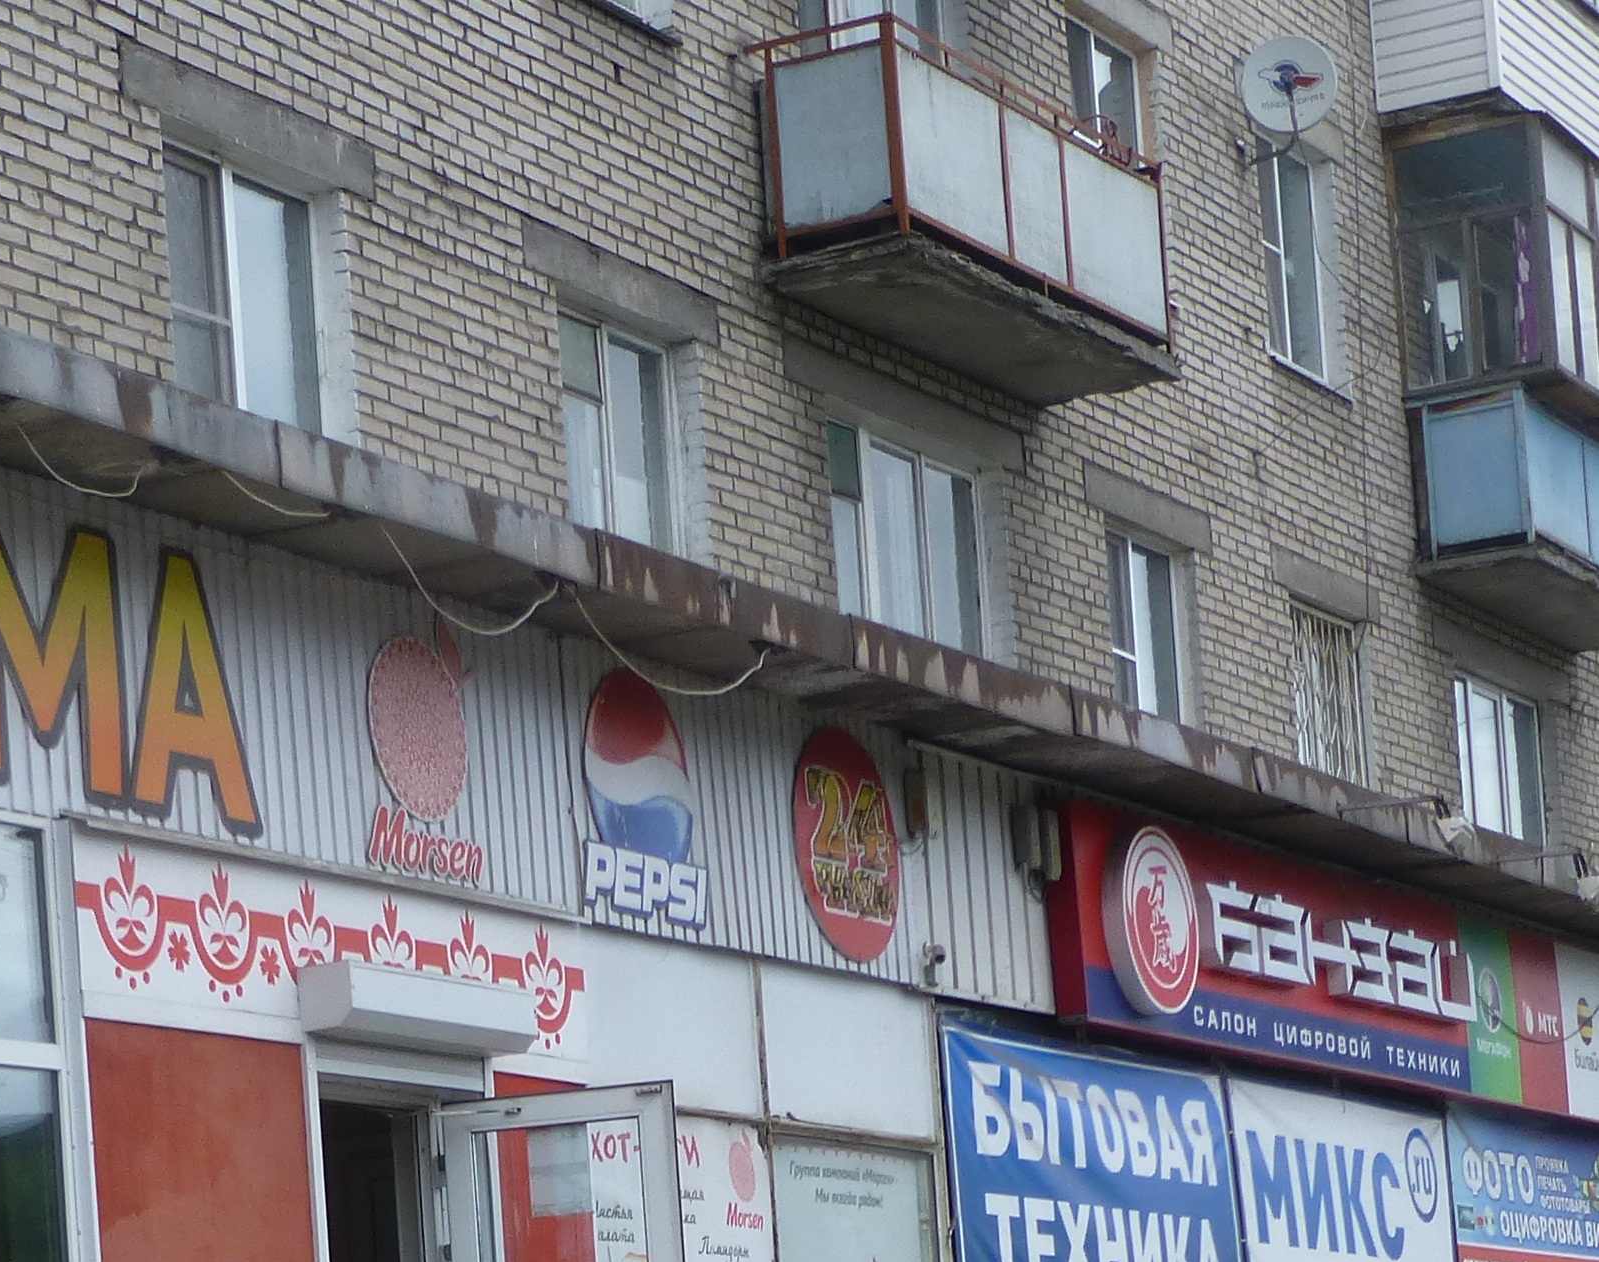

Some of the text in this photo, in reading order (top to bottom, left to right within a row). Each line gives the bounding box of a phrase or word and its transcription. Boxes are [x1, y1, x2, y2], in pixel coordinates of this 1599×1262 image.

[368, 804, 484, 885] Morsen
[583, 841, 708, 931] PEPSI
[1192, 1005, 1461, 1078] САЛОН ЦИФРОВОЙ ТЕХНИКИ
[1537, 1010, 1560, 1038] МТС
[968, 1061, 1219, 1187] БЫТОВАЯ
[815, 1187, 830, 1202] Мы
[1245, 1129, 1405, 1261] МИКС
[1412, 1155, 1433, 1196] .ru
[1462, 1147, 1534, 1205] ФОТО
[597, 1228, 636, 1243] алата
[726, 1202, 763, 1231] Morsen
[1500, 1210, 1583, 1244] ОЦИФРОВКА
